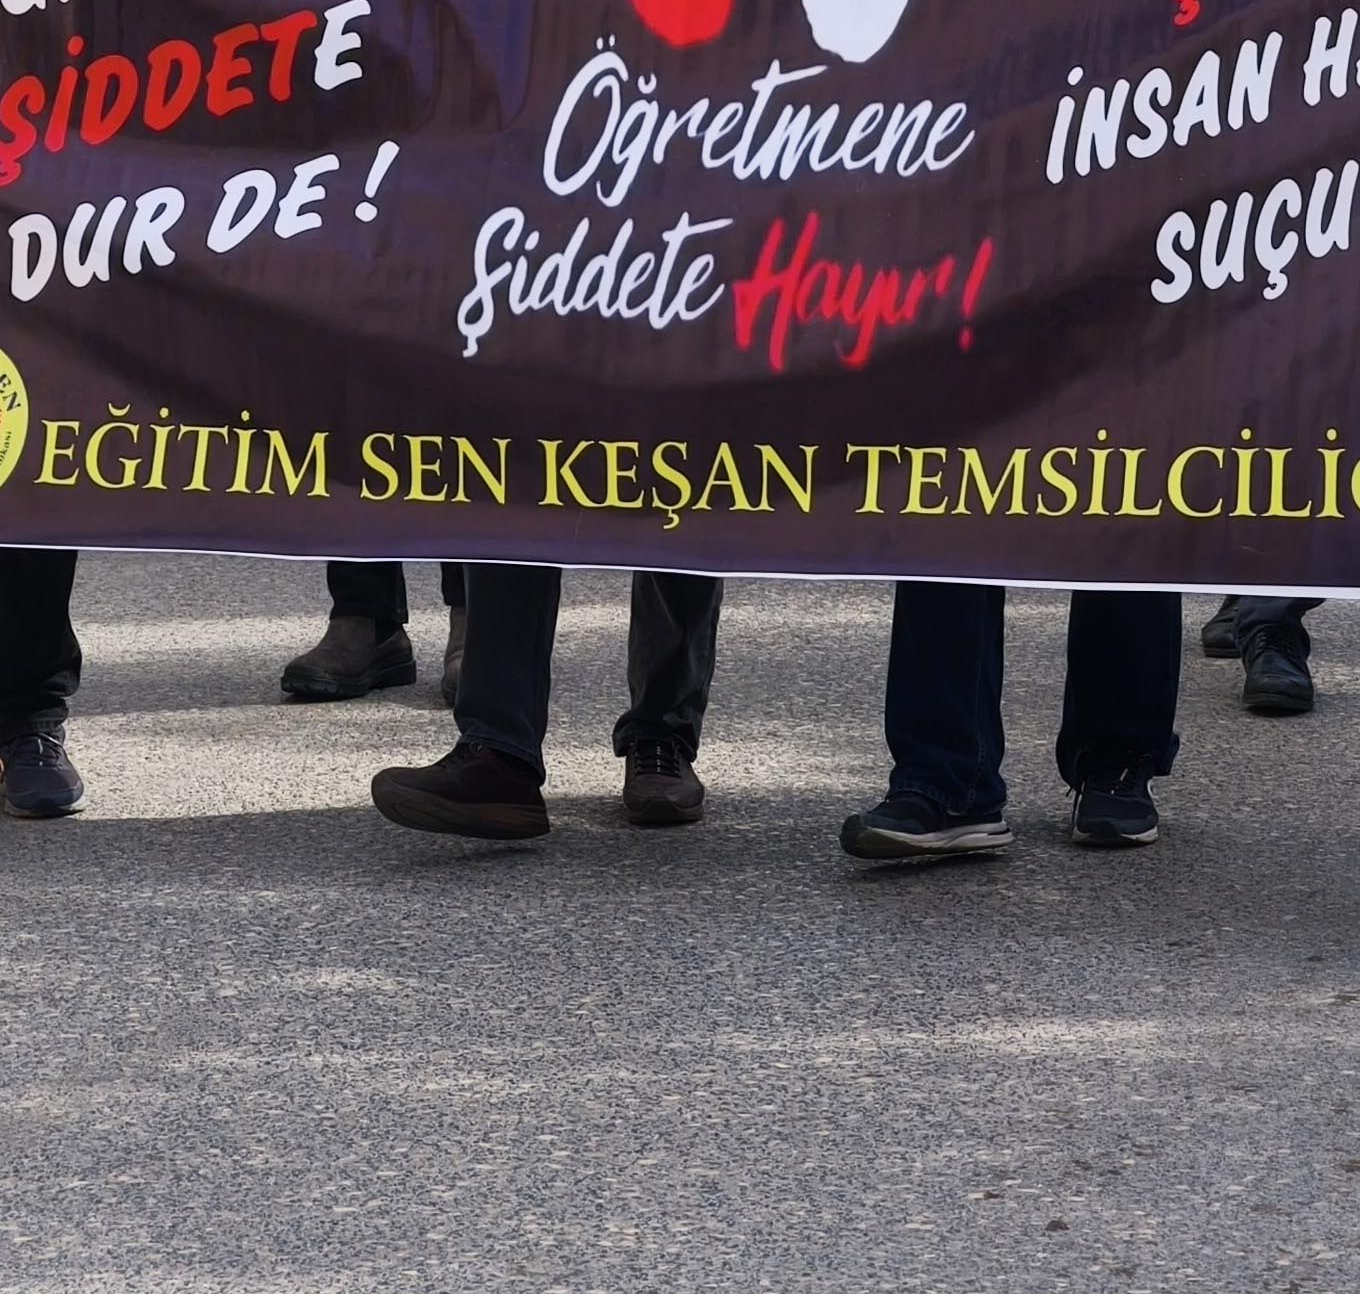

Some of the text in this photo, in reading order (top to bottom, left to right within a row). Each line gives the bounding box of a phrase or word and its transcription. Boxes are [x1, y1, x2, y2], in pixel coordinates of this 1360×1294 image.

[543, 34, 975, 207] Öğretmene
[1045, 31, 1281, 185] İNSAN
[8, 186, 185, 303] DUR
[206, 156, 340, 254] DE
[457, 206, 994, 374] Şiddete Hayır!
[34, 403, 330, 498] EĞİTİM
[360, 433, 512, 505] SEN
[537, 439, 820, 530] KEŞAN
